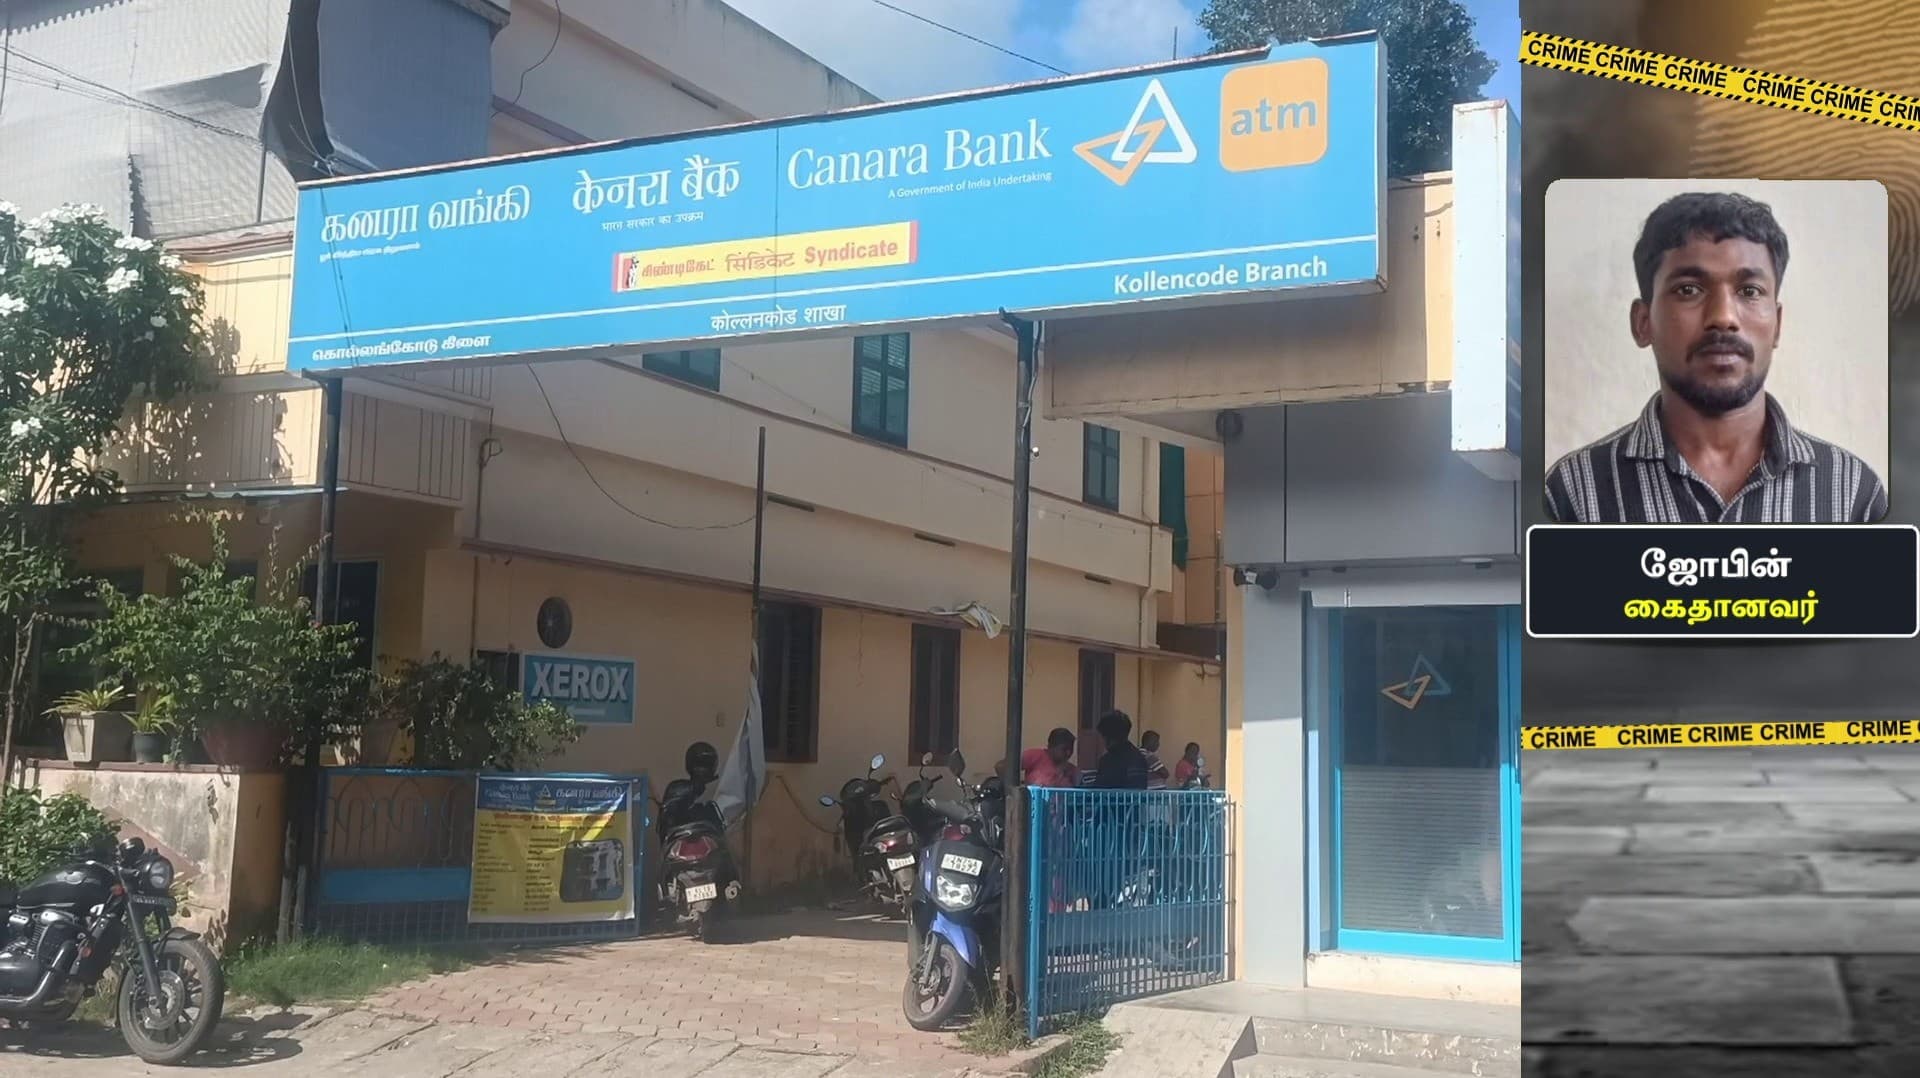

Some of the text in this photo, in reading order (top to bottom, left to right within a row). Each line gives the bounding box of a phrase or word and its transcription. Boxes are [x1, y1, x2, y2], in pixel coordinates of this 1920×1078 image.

[1231, 96, 1317, 137] atm
[787, 118, 1053, 190] Canara Bank
[572, 153, 741, 214] केनरा बैंक
[888, 171, 1053, 199] A Government of India Undertaking
[320, 183, 531, 243] கனரா வங்கி
[725, 247, 796, 273] सिंडिकेट
[804, 239, 899, 267] Syndicate
[1114, 255, 1328, 295] Kollencode Branch
[711, 303, 847, 331] कोल्लनकोड शाखा
[531, 661, 629, 700] XEROX
